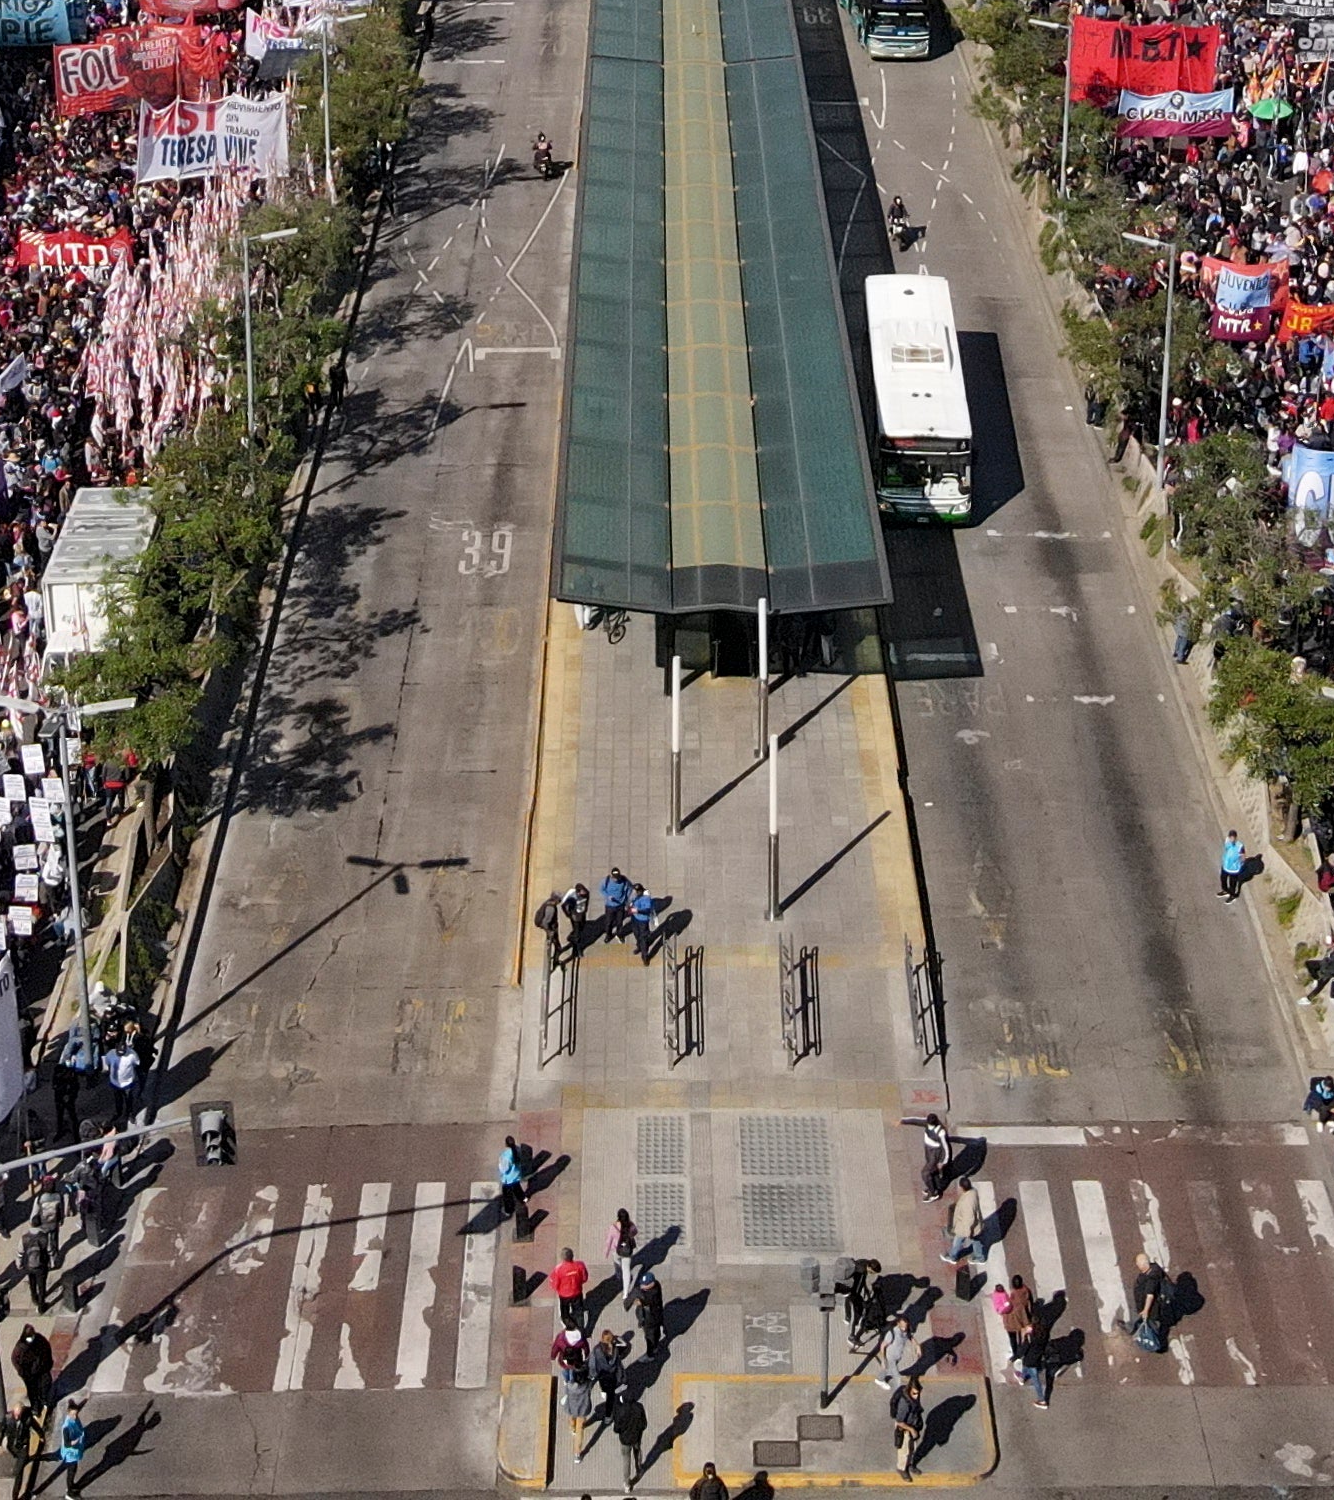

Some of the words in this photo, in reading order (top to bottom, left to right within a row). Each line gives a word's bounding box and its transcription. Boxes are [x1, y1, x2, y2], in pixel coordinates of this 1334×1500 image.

[0, 17, 58, 44] PIE
[59, 46, 129, 97] FOL
[143, 101, 216, 138] MST
[225, 114, 239, 124] SIN
[1126, 107, 1179, 121] CUBa
[1183, 107, 1224, 124] MTR
[225, 125, 260, 137] TRABAJO
[160, 135, 216, 166] TERESA
[224, 135, 257, 165] VIVE
[1218, 315, 1251, 334] MTR
[458, 530, 513, 575] 39
